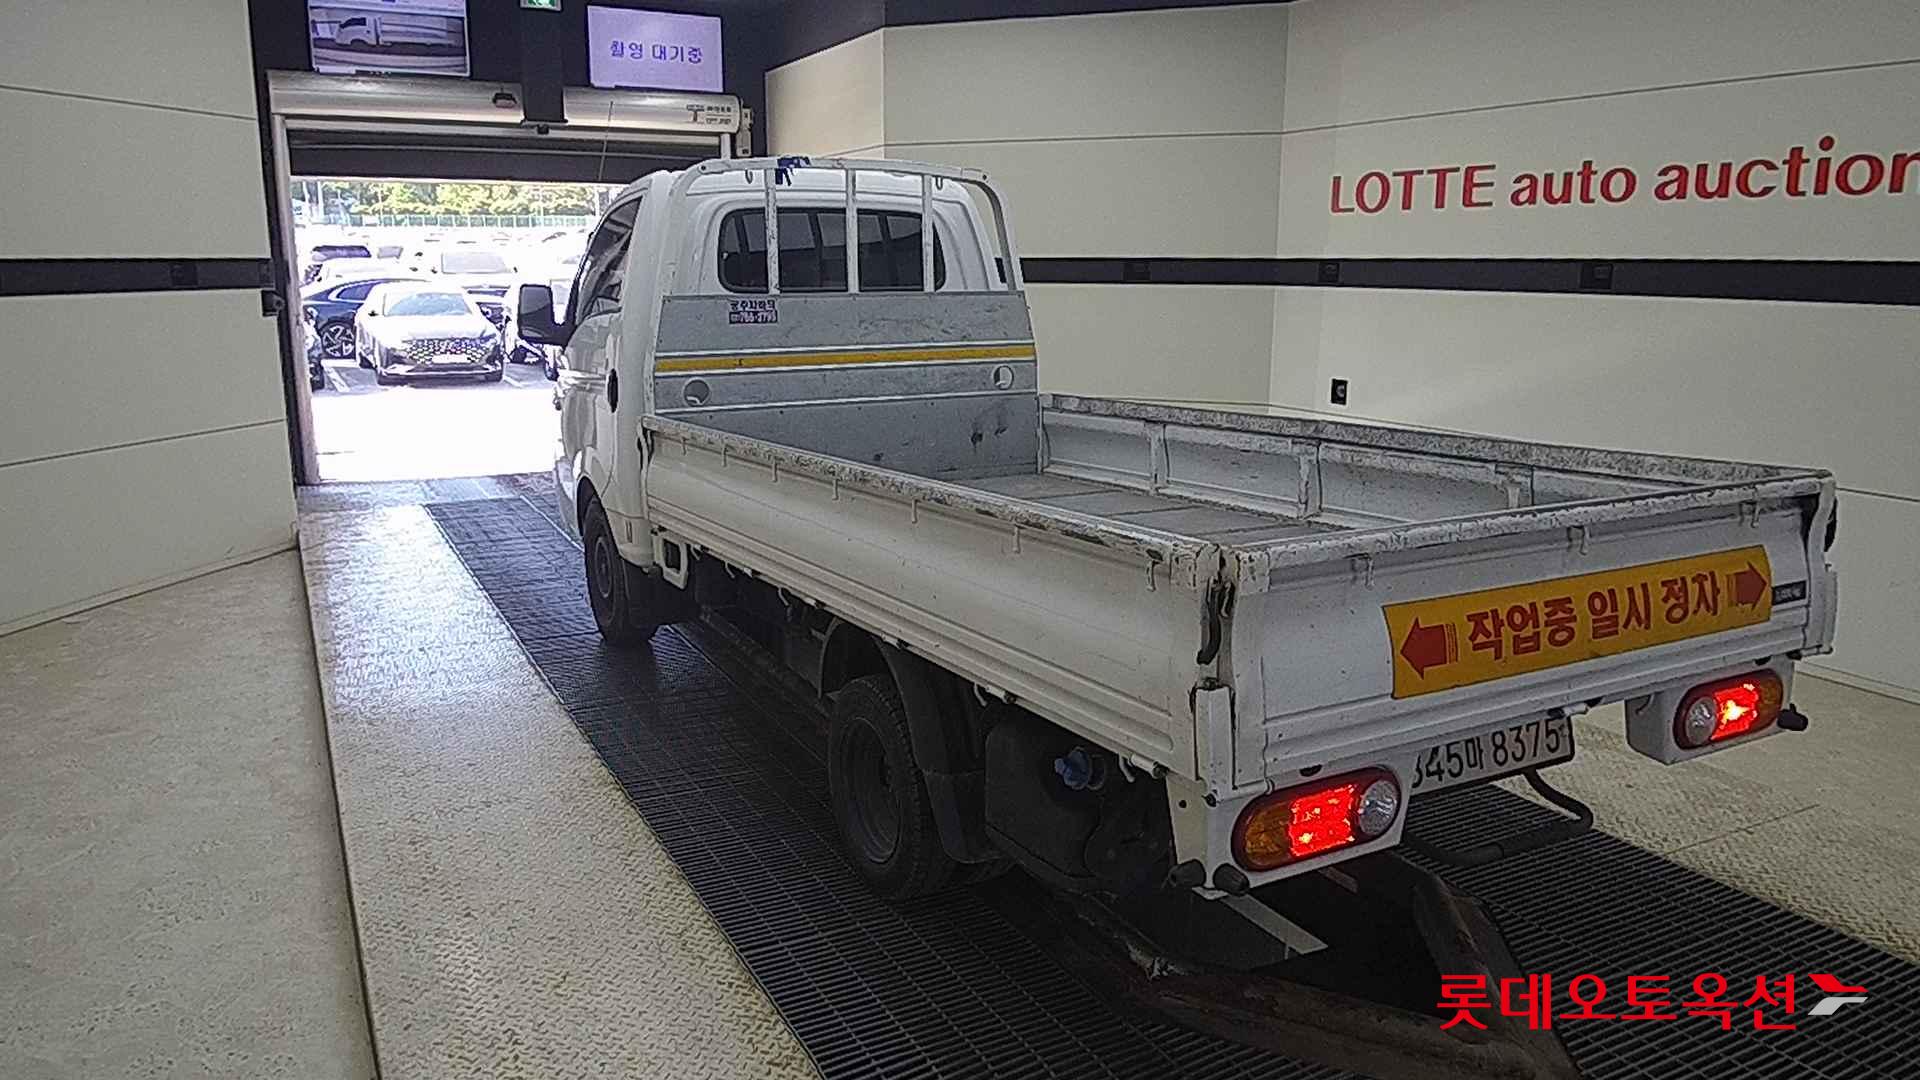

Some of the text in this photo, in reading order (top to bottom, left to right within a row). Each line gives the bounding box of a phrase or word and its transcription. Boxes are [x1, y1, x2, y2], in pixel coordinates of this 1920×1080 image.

[610, 40, 703, 64] 촬영 대기중
[1329, 163, 1497, 215] LOTTE
[1509, 159, 1637, 206] auto
[1466, 570, 1720, 661] 작업중 일시 정차
[1491, 719, 1560, 767] 8375
